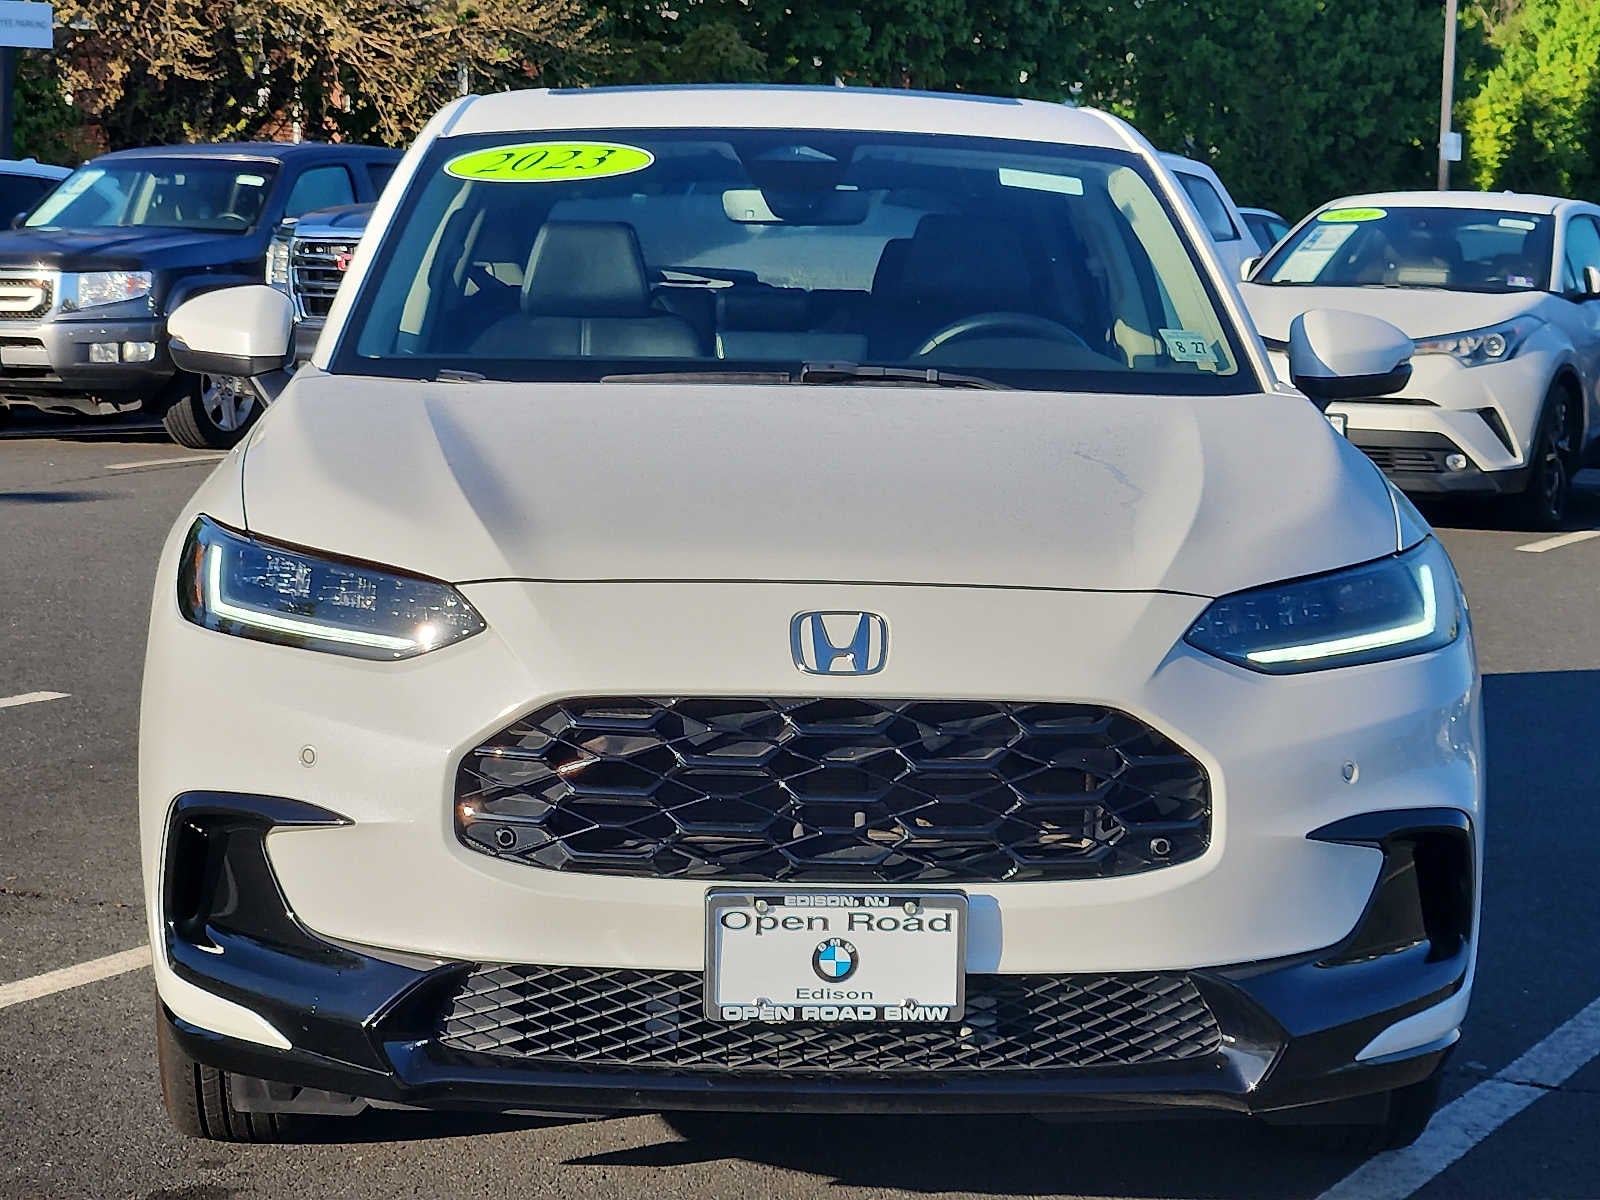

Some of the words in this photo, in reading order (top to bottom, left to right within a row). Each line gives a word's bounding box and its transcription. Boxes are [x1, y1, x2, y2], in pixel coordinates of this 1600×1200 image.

[474, 149, 617, 174] 2023
[1175, 341, 1186, 353] 8
[1190, 341, 1207, 354] 27
[784, 895, 859, 907] EDISON,
[864, 896, 890, 907] NJ
[720, 911, 829, 936] Open
[848, 912, 952, 932] Road
[817, 938, 856, 954] BMW
[796, 988, 873, 1000] Edison
[722, 1006, 795, 1021] OPEN
[801, 1006, 877, 1021] ROAD
[884, 1006, 949, 1021] BMW
